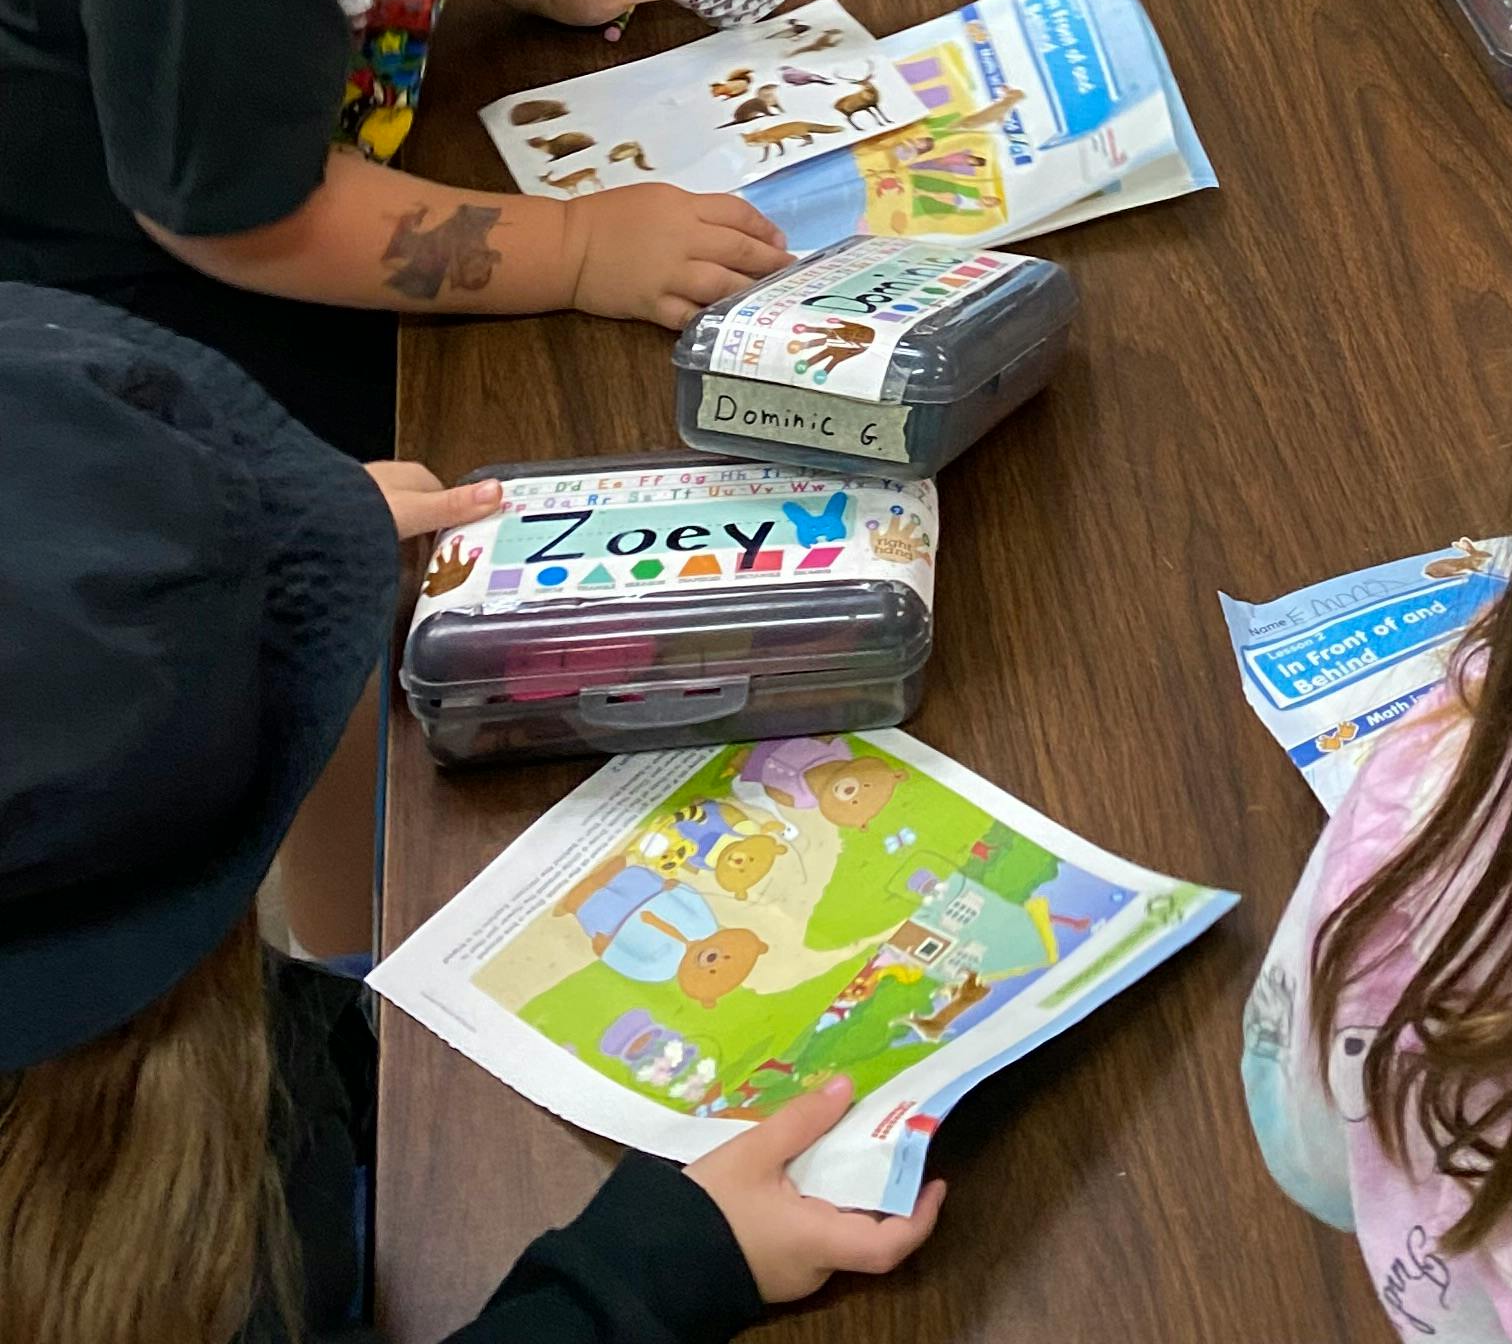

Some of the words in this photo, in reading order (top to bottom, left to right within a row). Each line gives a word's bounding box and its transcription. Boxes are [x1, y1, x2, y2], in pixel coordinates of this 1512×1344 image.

[802, 255, 963, 314] Dominic
[555, 480, 583, 493] Dd
[597, 479, 624, 490] Ee
[638, 475, 664, 487] Ff
[679, 473, 707, 485] Gg
[587, 494, 612, 506] Rr
[669, 488, 694, 500] Tt
[708, 485, 735, 497] Uu
[750, 483, 773, 495] Vv
[791, 481, 825, 493] Ww
[520, 509, 776, 570] Zoey
[877, 537, 913, 552] right
[1249, 618, 1287, 637] Name
[1277, 661, 1306, 679] In
[1307, 630, 1369, 668] Front
[1373, 616, 1399, 636] of
[1402, 600, 1449, 625] and
[1267, 638, 1315, 660] Lesson
[1317, 632, 1327, 643] 2
[1292, 647, 1380, 696] Behind
[1366, 700, 1402, 727] Math
